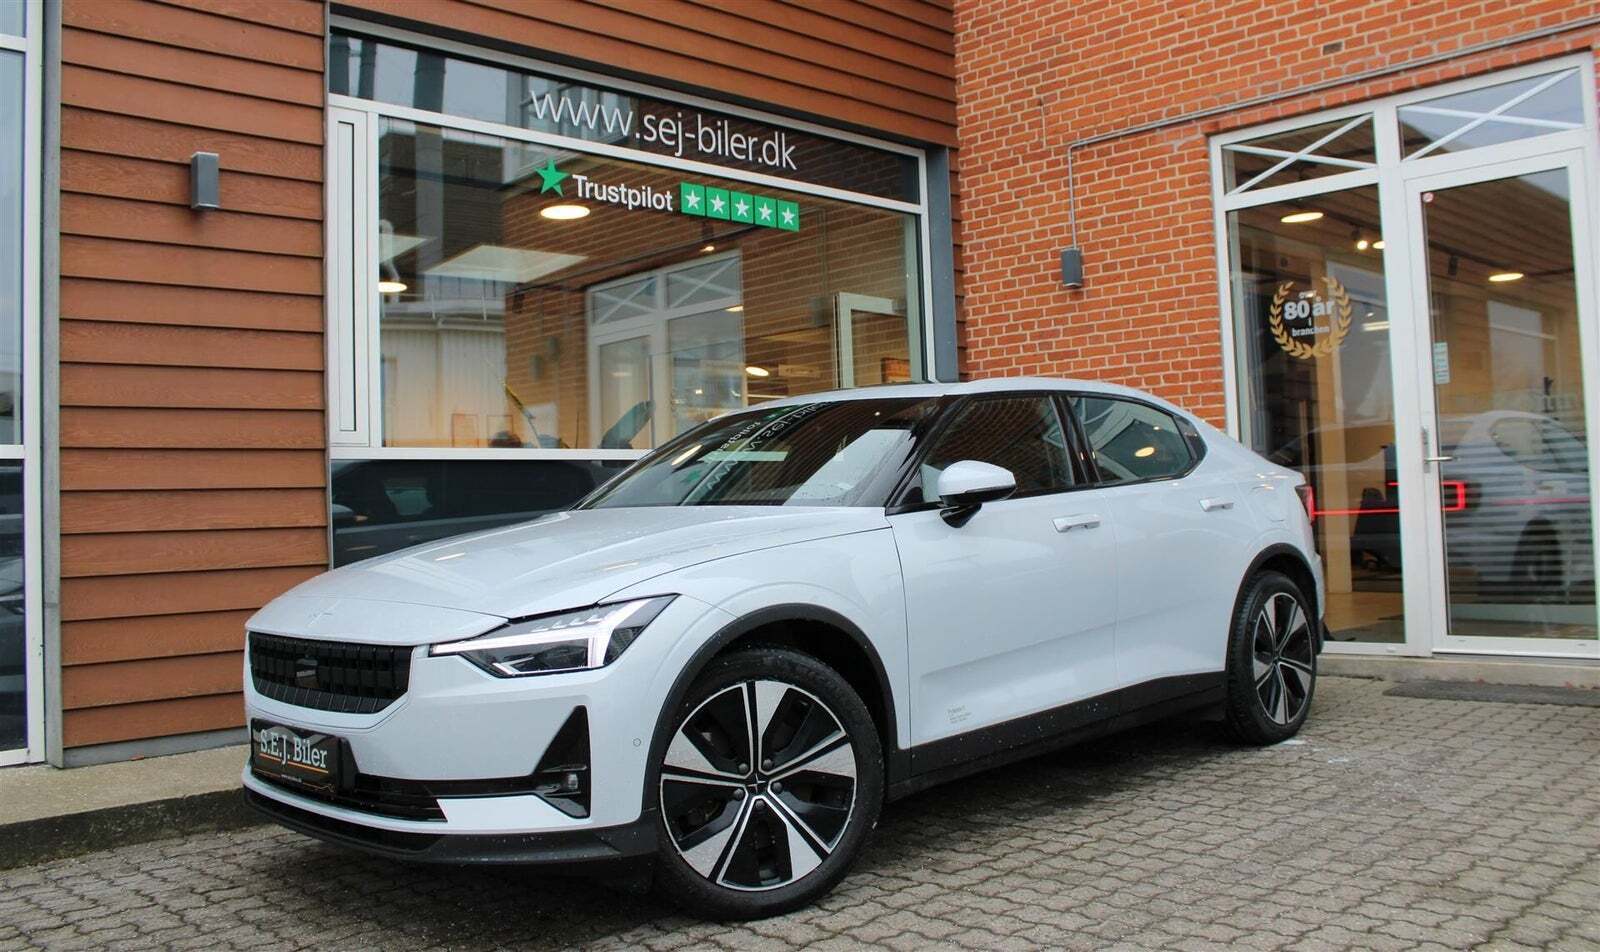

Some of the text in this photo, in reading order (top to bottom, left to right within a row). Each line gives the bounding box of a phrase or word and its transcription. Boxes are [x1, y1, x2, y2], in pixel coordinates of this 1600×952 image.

[529, 91, 797, 170] www.sej-biler.dk
[572, 174, 674, 212] Trustpilot
[1284, 296, 1335, 320] 80 år
[260, 729, 328, 768] S.E.J. Biler
